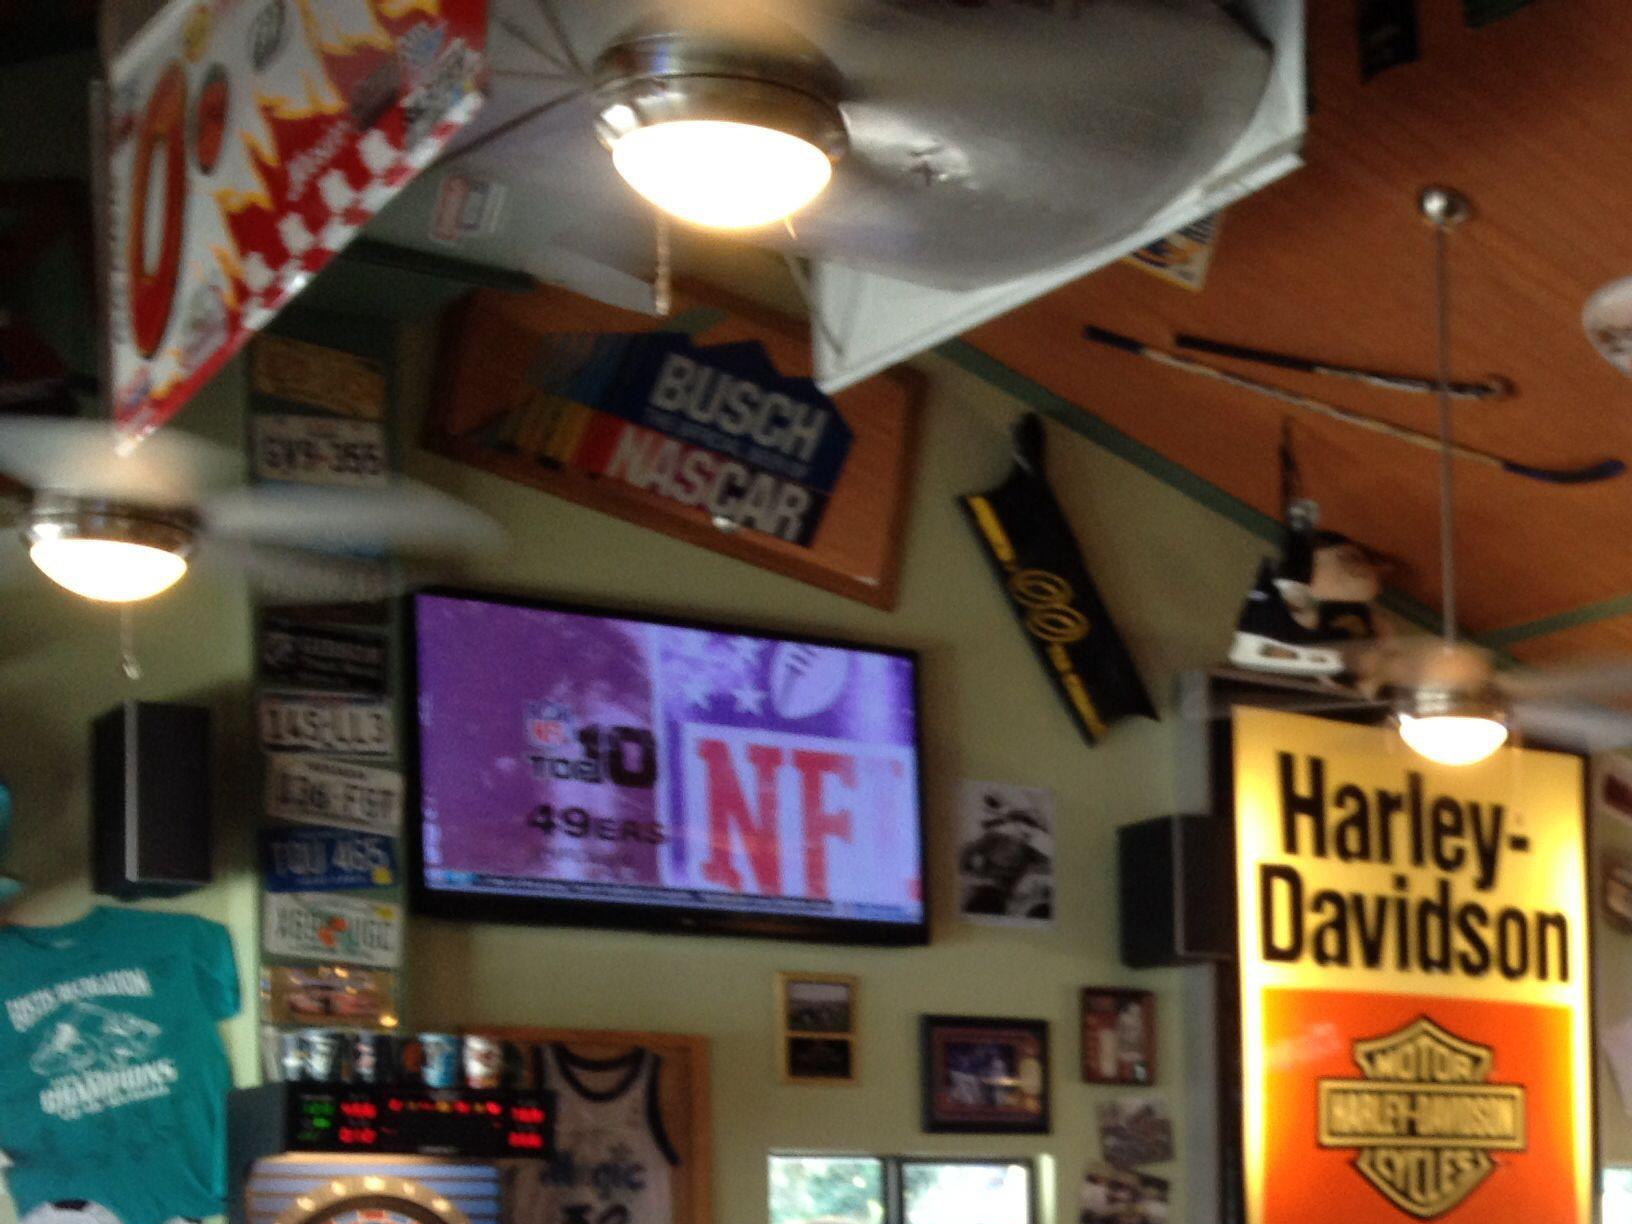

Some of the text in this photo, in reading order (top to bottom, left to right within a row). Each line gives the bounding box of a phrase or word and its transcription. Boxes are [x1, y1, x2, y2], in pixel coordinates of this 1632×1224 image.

[650, 353, 829, 461] BUSCH
[605, 426, 812, 541] NASCAR
[528, 804, 668, 845] 49ERS
[1275, 749, 1532, 893] Harley-
[1260, 863, 1570, 983] Davidson
[1373, 1038, 1482, 1081] MOTOR
[1369, 1148, 1484, 1204] CYCLES
